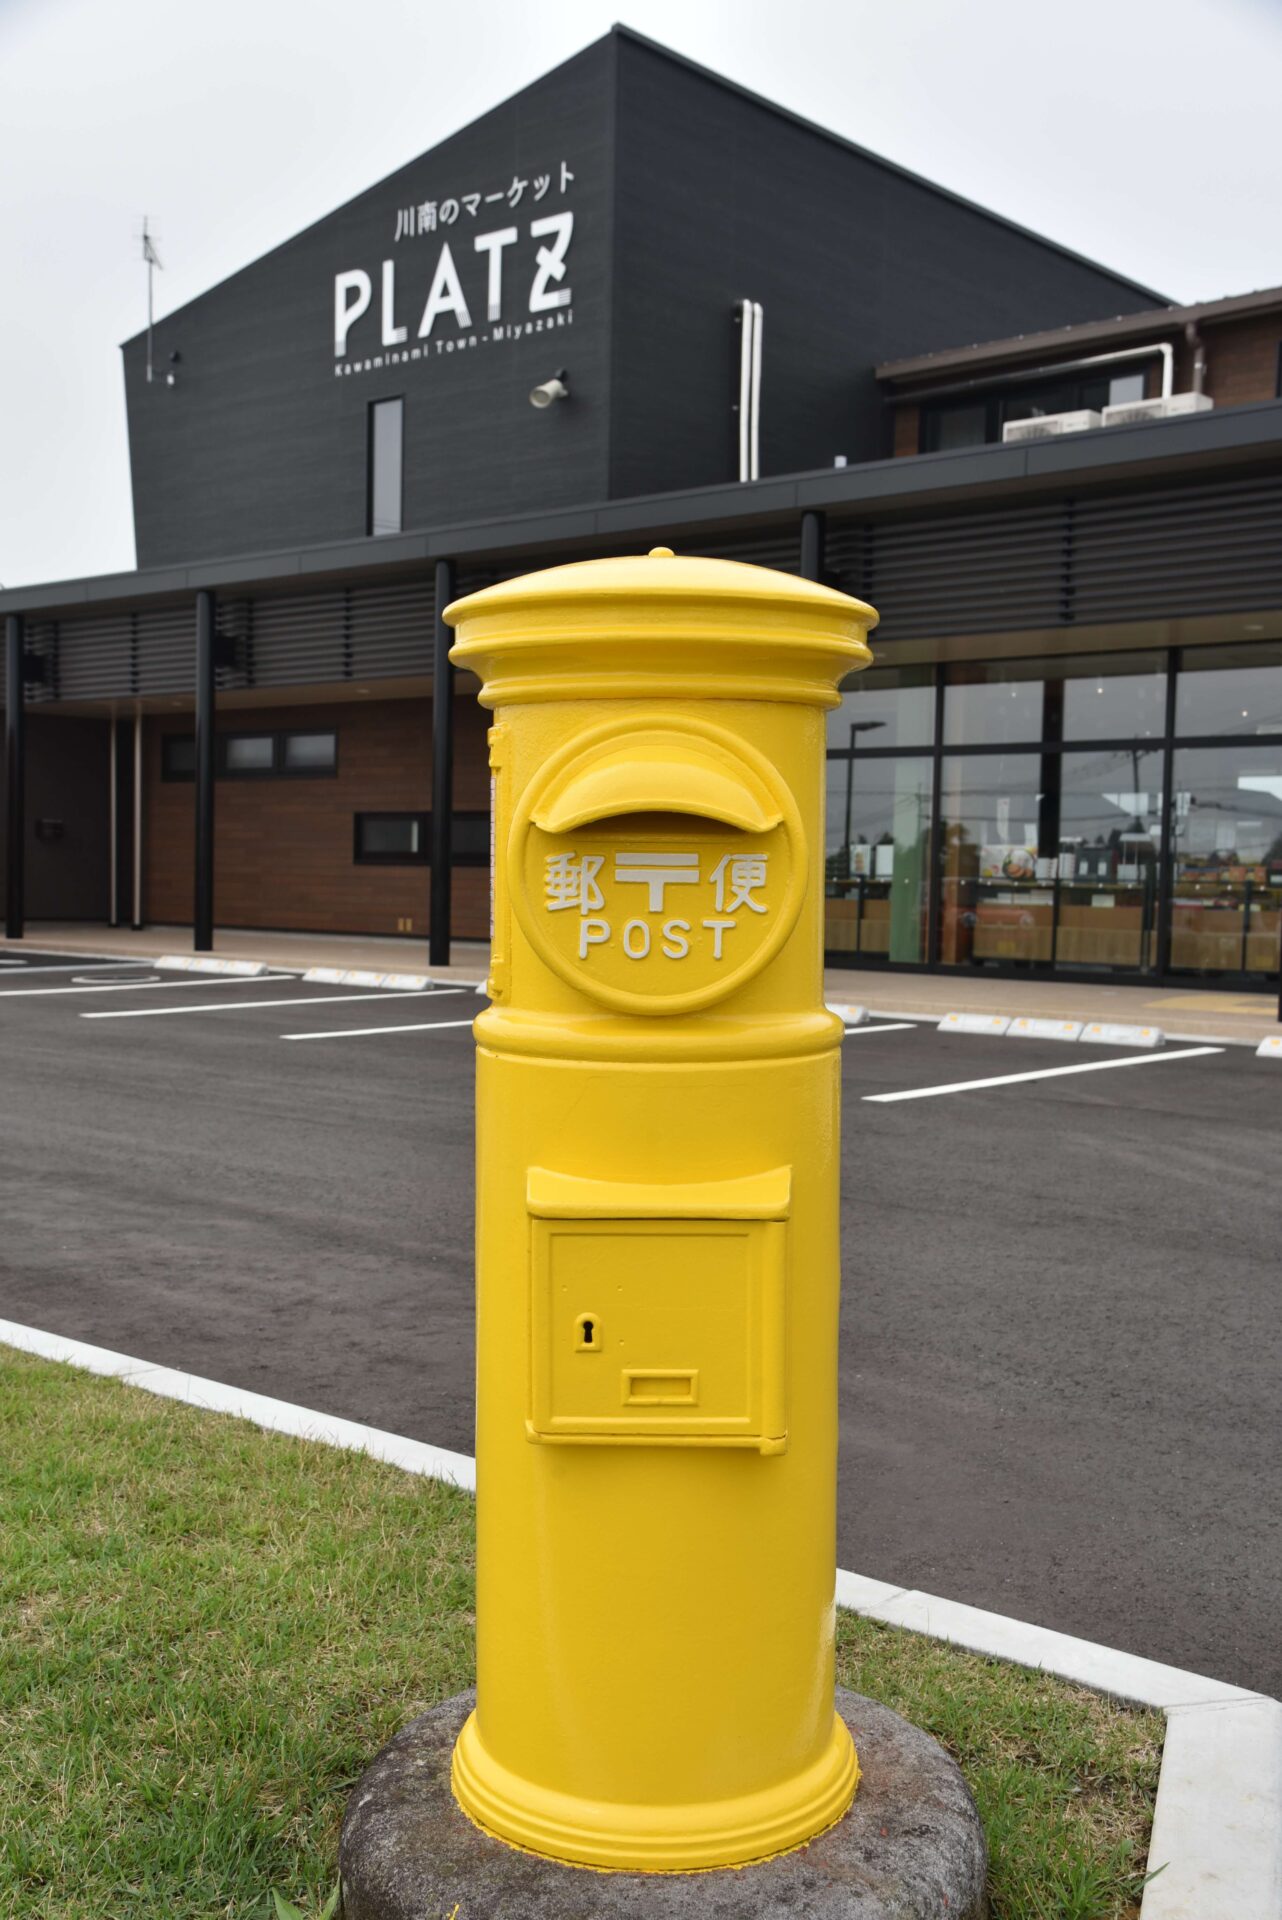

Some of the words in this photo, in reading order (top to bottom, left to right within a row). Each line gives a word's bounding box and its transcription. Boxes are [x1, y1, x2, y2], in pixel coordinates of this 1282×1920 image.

[394, 161, 574, 242] 川南のマーケット
[334, 211, 574, 358] PLATZ
[334, 343, 429, 377] Kawaminami
[579, 918, 736, 960] POST
